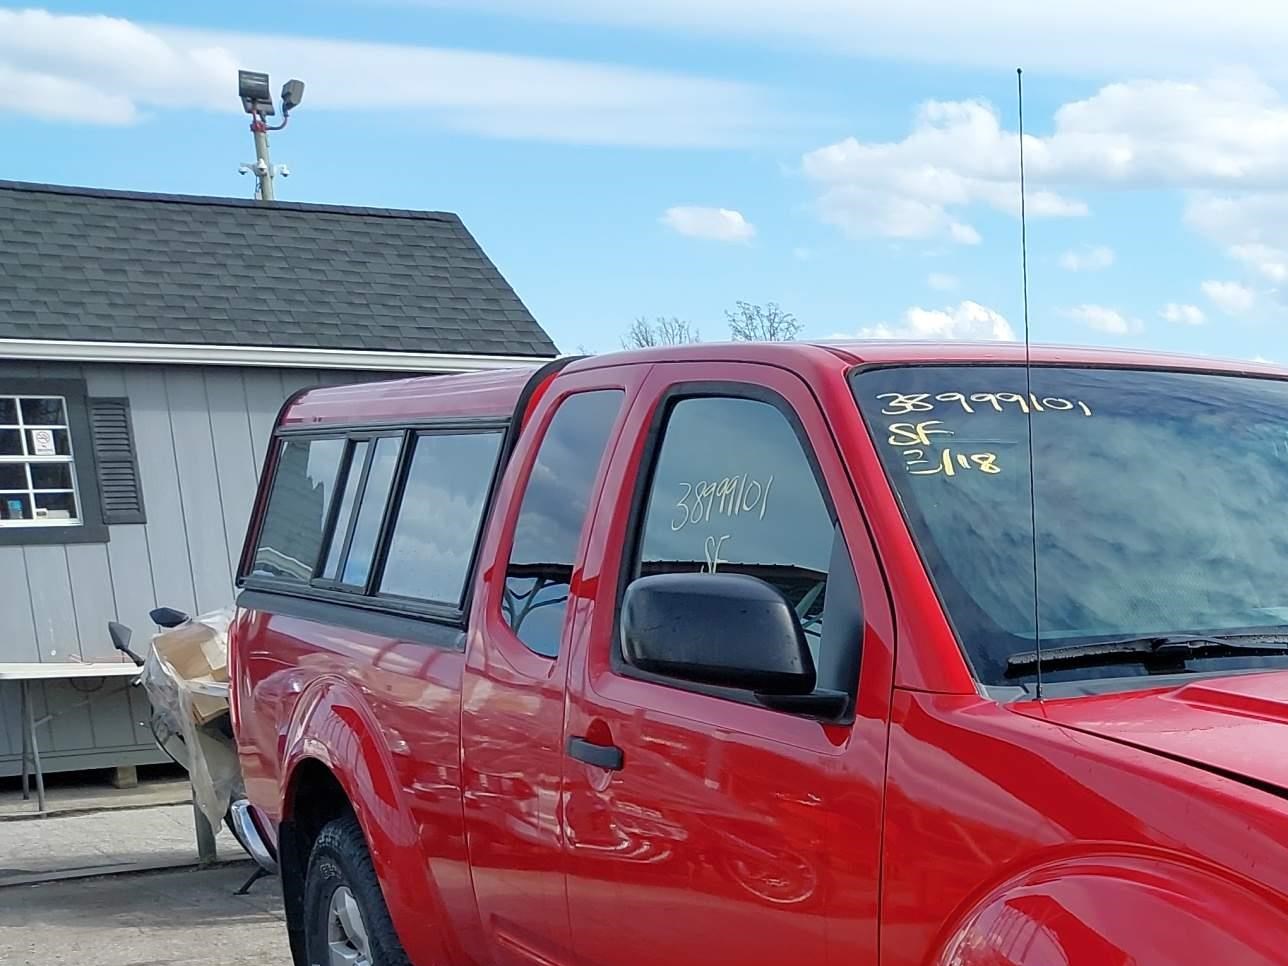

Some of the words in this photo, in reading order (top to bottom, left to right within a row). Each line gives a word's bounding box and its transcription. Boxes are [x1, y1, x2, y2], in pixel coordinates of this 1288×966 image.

[876, 392, 1092, 416] 38999101
[888, 420, 954, 446] SF
[671, 473, 774, 531] 38999101
